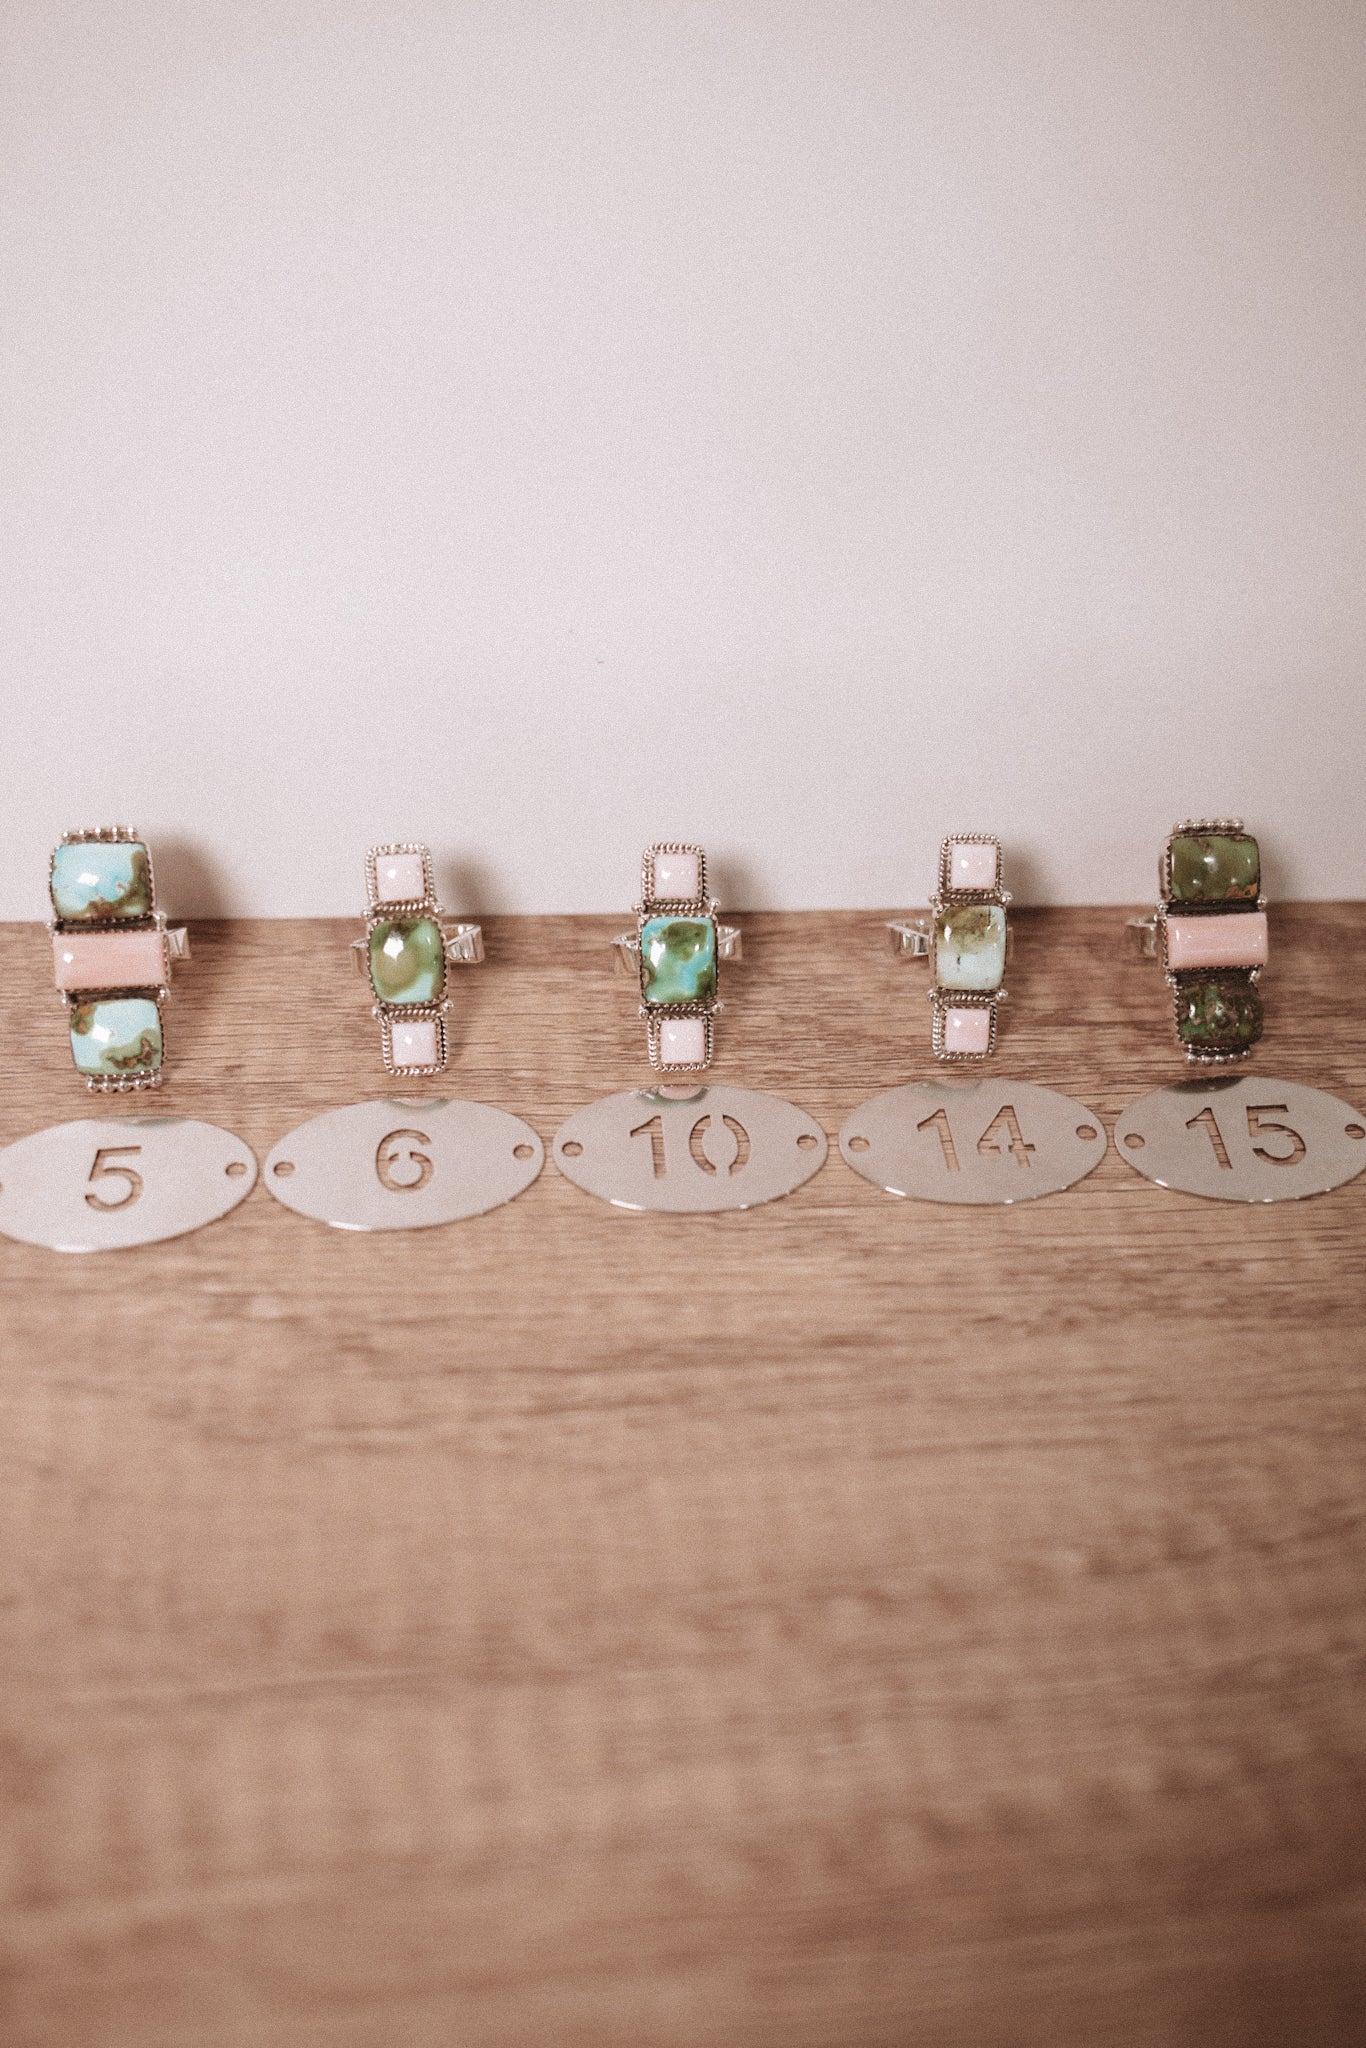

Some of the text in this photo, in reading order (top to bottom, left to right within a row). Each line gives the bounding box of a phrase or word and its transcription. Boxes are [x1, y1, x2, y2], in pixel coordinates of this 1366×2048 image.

[374, 1128, 436, 1192] 6
[629, 1114, 751, 1179] 10
[916, 1105, 1036, 1173] 14
[1186, 1104, 1307, 1170] 15
[84, 1145, 145, 1213] 5
